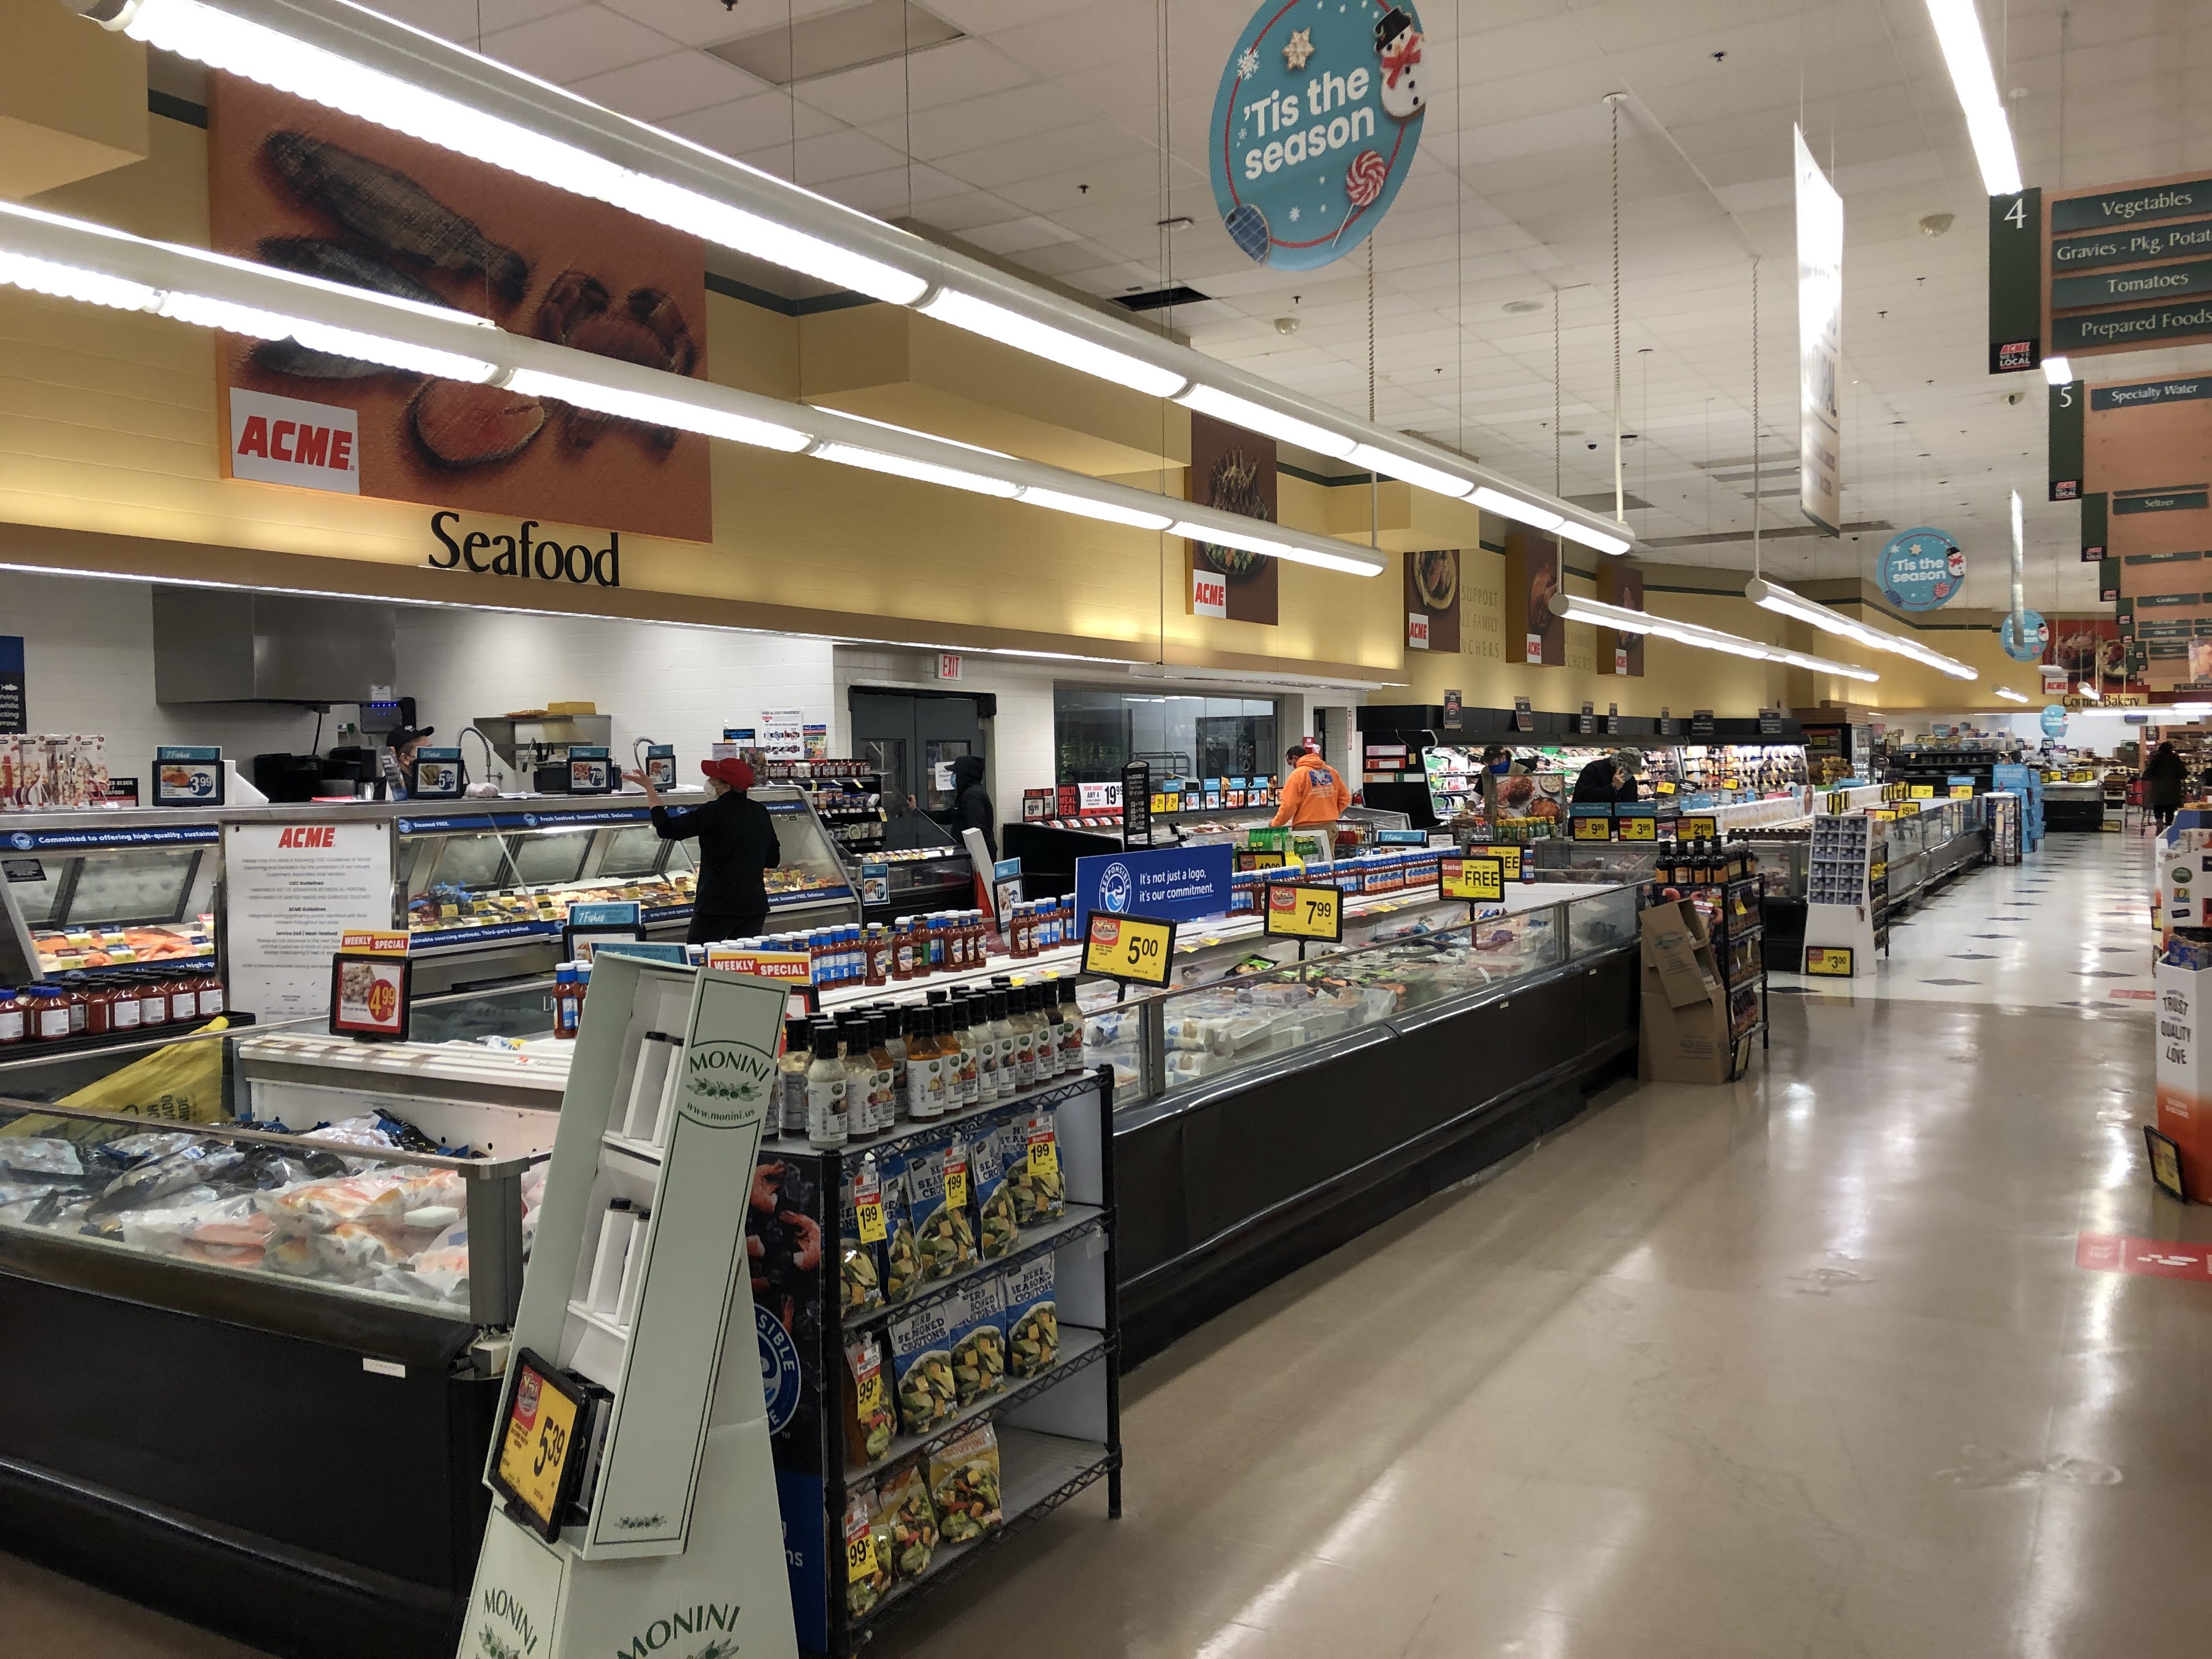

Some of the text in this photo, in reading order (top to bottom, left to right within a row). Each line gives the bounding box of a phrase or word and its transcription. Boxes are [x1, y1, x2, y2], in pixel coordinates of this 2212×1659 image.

[1244, 67, 1370, 138] 'Tis the
[1245, 106, 1374, 180] season
[2003, 198, 2027, 229] 4
[2102, 191, 2192, 218] Vegetables
[2057, 243, 2117, 261] Gravies
[2107, 273, 2189, 294] Tomatoes
[2082, 308, 2212, 339] Prepared Foods
[2000, 357, 2031, 366] LOCAL
[2059, 386, 2073, 408] 5
[2111, 384, 2198, 403] Specialty Water
[238, 415, 353, 471] ACME
[428, 511, 620, 587] Seafood
[1919, 558, 1944, 569] the
[1893, 570, 1946, 583] season
[1195, 583, 1224, 607] ACME
[1462, 585, 1498, 607] SUPPORT
[1409, 622, 1427, 640] ACME
[1474, 613, 1498, 633] FAMILY
[943, 655, 960, 678] EXIT
[2104, 695, 2140, 707] Bakery
[1059, 787, 1075, 795] MULTI
[1059, 804, 1076, 816] DEAL
[38, 836, 86, 844] Committed
[99, 833, 132, 842] offering
[133, 832, 183, 840] high-quality,
[278, 827, 336, 848] ACME
[1101, 865, 1130, 893] RESPONSIBLE
[1139, 868, 1206, 885] It's not just a logo,
[1465, 871, 1499, 887] FREE
[1139, 882, 1214, 902] it's our commitment.
[345, 936, 405, 949] WEEKLY SPECIAL
[434, 934, 458, 943] sourcing
[714, 960, 805, 976] WEEKLY SPECIAL
[2162, 996, 2189, 1016] TRUST
[2161, 1020, 2191, 1043] QUALITY
[690, 1051, 770, 1082] MONINI
[687, 1102, 755, 1121] www.monini.us
[1032, 1134, 1048, 1143] Sale!
[859, 1195, 875, 1204] Sale!
[483, 1587, 538, 1656] MONINI
[617, 1603, 741, 1659] MONINI
